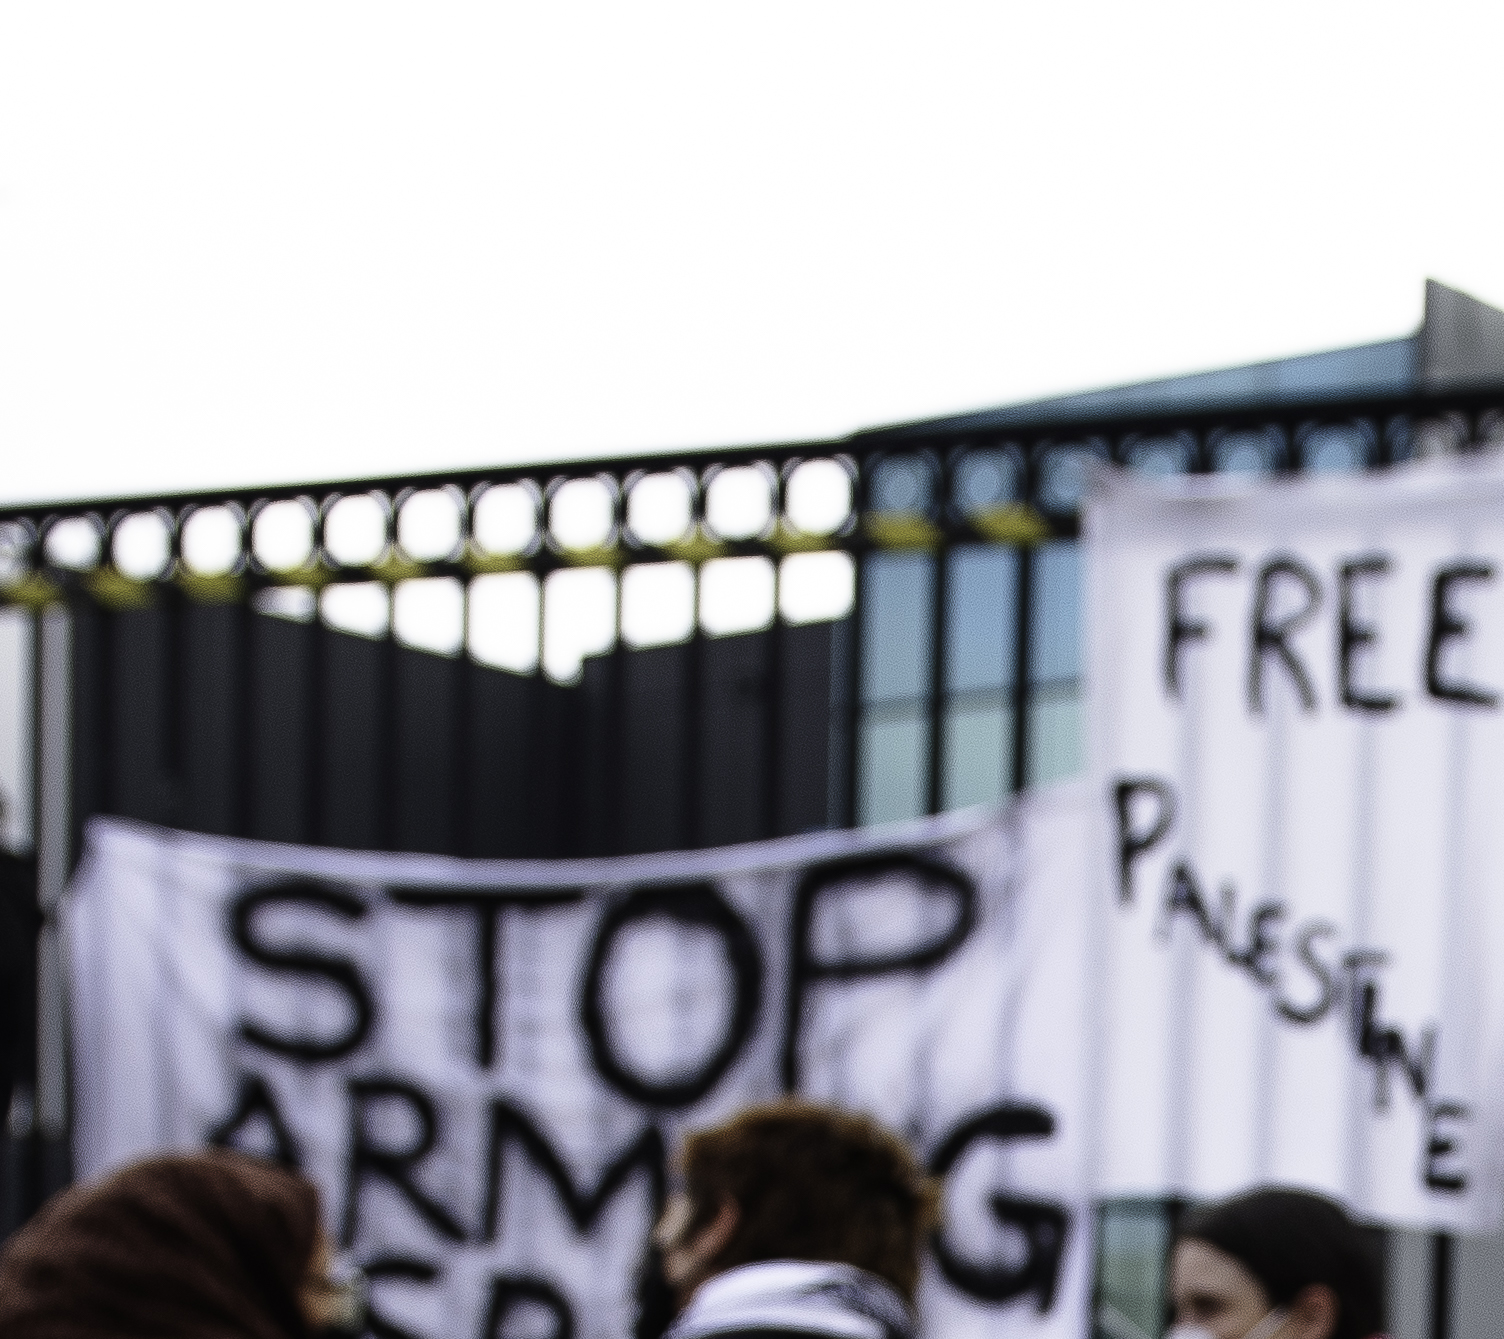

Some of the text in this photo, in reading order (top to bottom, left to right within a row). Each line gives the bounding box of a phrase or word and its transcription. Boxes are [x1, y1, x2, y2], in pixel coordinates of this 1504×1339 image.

[1165, 557, 1504, 716] FREE
[231, 850, 978, 1106] STOP
[1111, 776, 1476, 1192] PALESTINE
[208, 1078, 1064, 1322] ARMG
